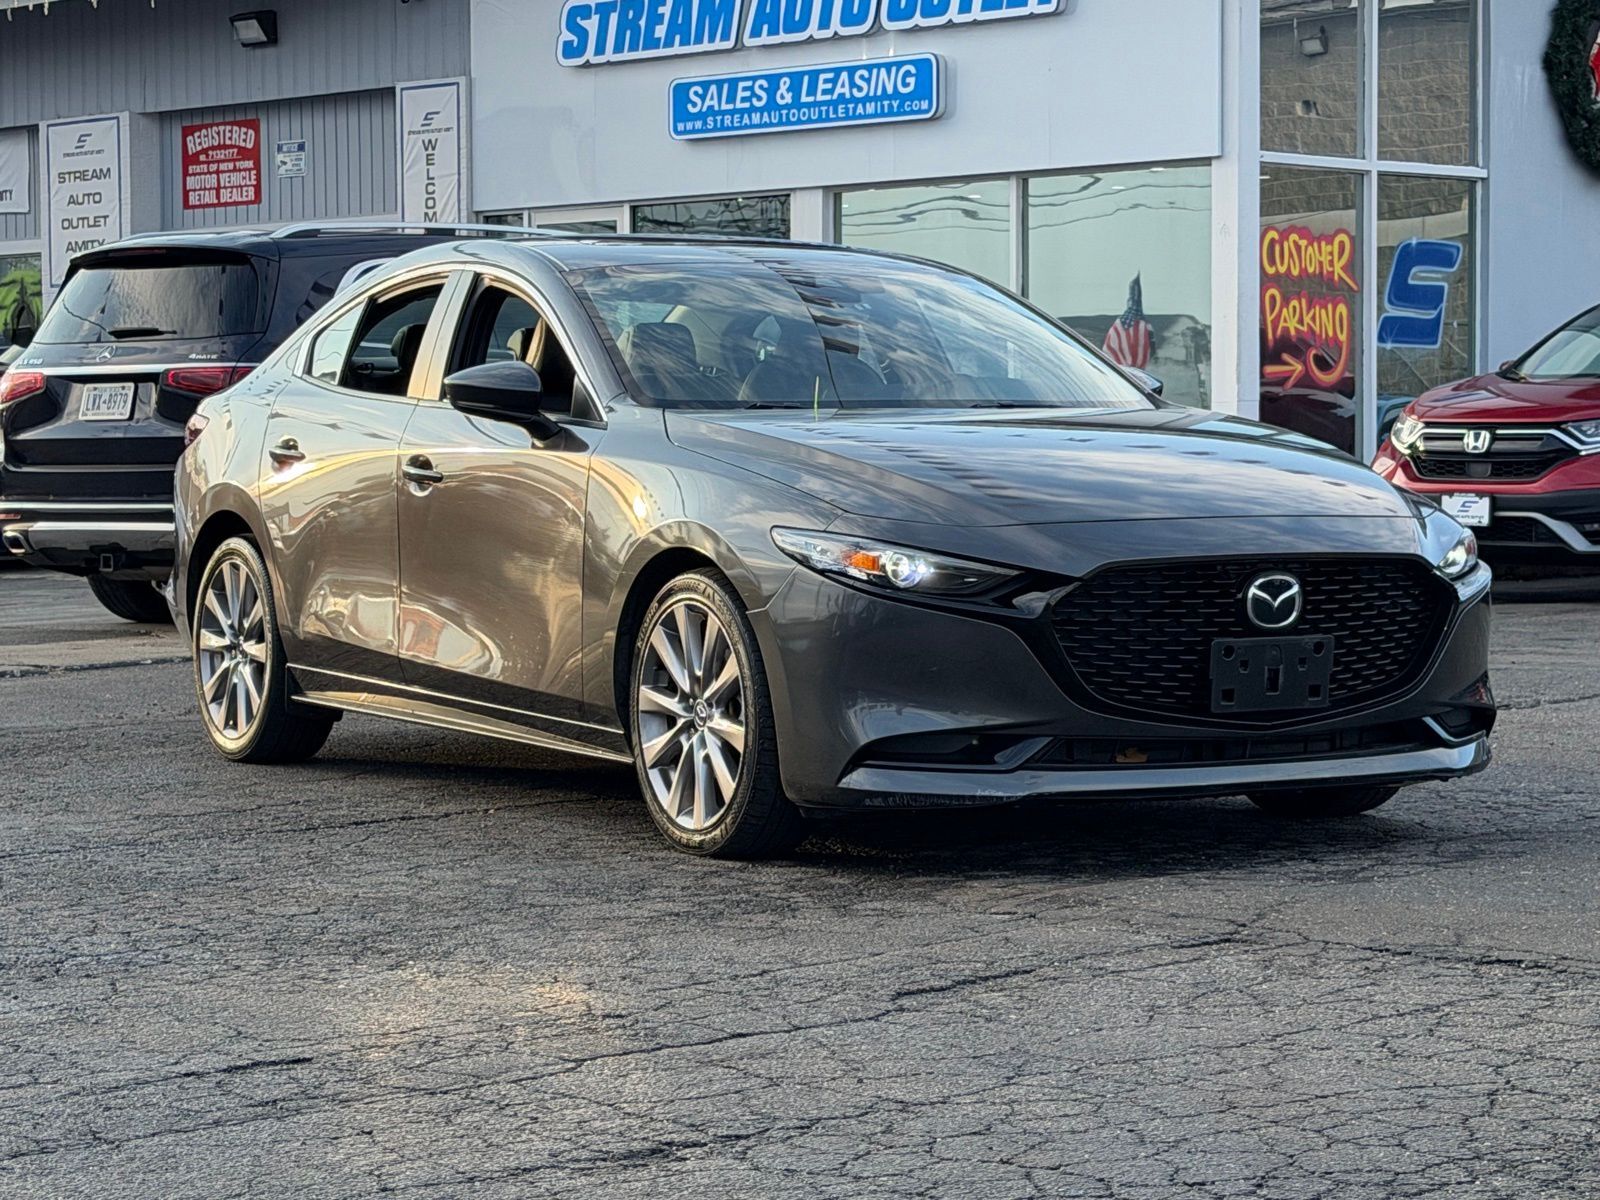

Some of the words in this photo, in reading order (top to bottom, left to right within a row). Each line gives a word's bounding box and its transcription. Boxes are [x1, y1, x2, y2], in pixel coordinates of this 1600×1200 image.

[562, 0, 736, 60] STREAM
[686, 79, 769, 113] SALES
[776, 76, 793, 105] &
[800, 64, 917, 103] LEASING
[186, 125, 255, 156] REGISTERED
[58, 167, 111, 184] STREAM
[188, 164, 208, 174] STATE
[209, 163, 218, 171] OF
[219, 162, 234, 171] NEW
[235, 160, 254, 169] YORK
[186, 174, 218, 191] MOTOR
[219, 170, 257, 188] VEHICLE
[422, 138, 438, 223] WELCOM
[67, 192, 102, 207] AUTO
[188, 190, 219, 206] RETAIL
[220, 186, 255, 203] DEALER
[61, 215, 110, 230] OUTLET
[1262, 229, 1359, 292] CUSTOMER
